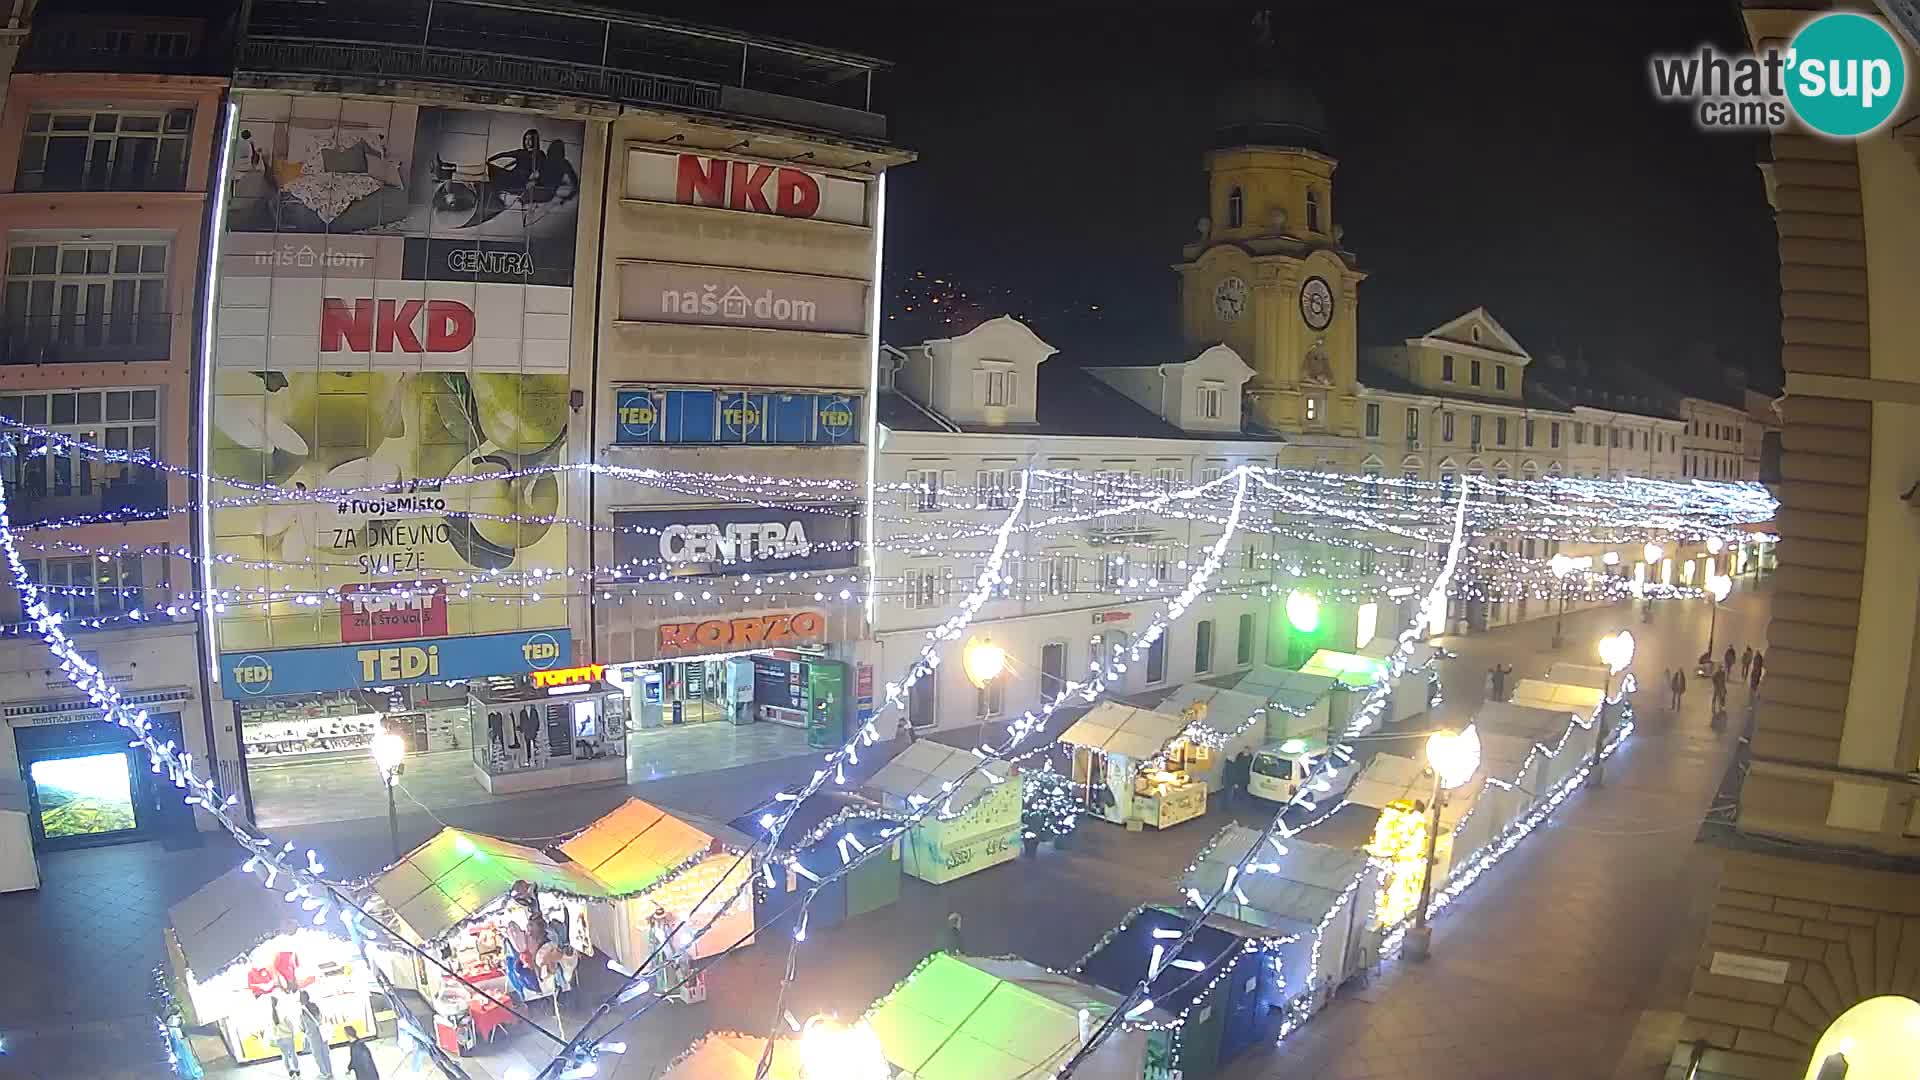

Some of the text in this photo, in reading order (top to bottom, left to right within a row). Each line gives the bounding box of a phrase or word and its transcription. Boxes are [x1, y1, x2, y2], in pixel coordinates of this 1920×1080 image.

[676, 154, 820, 218] NKD
[255, 243, 365, 269] naš dom
[447, 249, 536, 275] CENTRA
[662, 284, 817, 322] naš dom
[320, 297, 476, 354] NKD
[618, 407, 658, 424] TEDi
[723, 409, 760, 426] TEDi
[820, 411, 853, 427] TEDi
[333, 523, 450, 549] ZA DNEVNO
[659, 520, 811, 562] CENTRA
[659, 611, 825, 650] KORZO
[357, 645, 439, 682] TEDi
[522, 643, 560, 661] TEDi
[233, 666, 272, 683] TEDi
[533, 664, 605, 688] TOMMY
